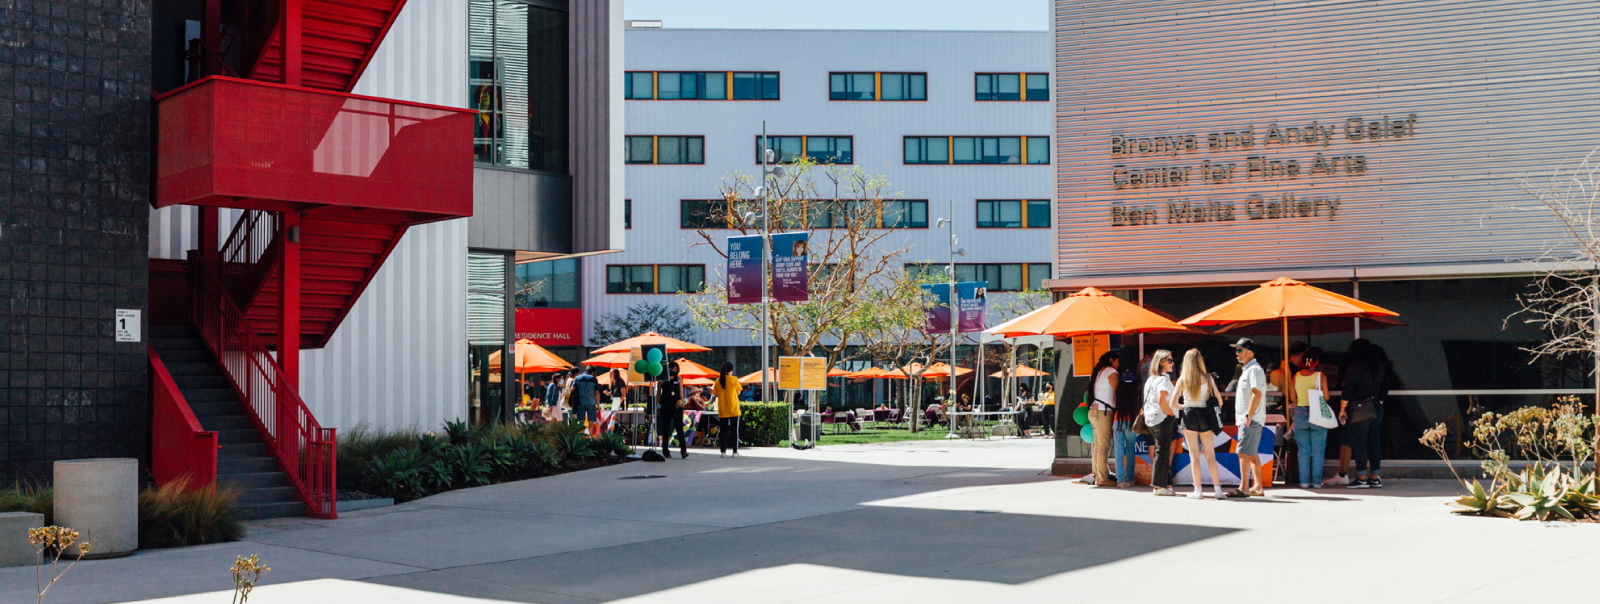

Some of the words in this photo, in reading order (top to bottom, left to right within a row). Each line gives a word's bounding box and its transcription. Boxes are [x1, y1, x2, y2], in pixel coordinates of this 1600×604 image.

[1109, 134, 1197, 157] Bronya
[1208, 125, 1255, 149] and
[1264, 121, 1335, 147] Andy
[1344, 114, 1417, 140] Galef
[1110, 165, 1192, 189] Center
[1201, 160, 1237, 183] for
[1245, 156, 1300, 179] Fine
[1310, 152, 1368, 176] Arts
[1110, 202, 1157, 227] Ben
[1167, 199, 1235, 224] Maltz
[1244, 193, 1340, 220] Gallery
[730, 251, 750, 259] BELONG
[120, 318, 125, 330] 1
